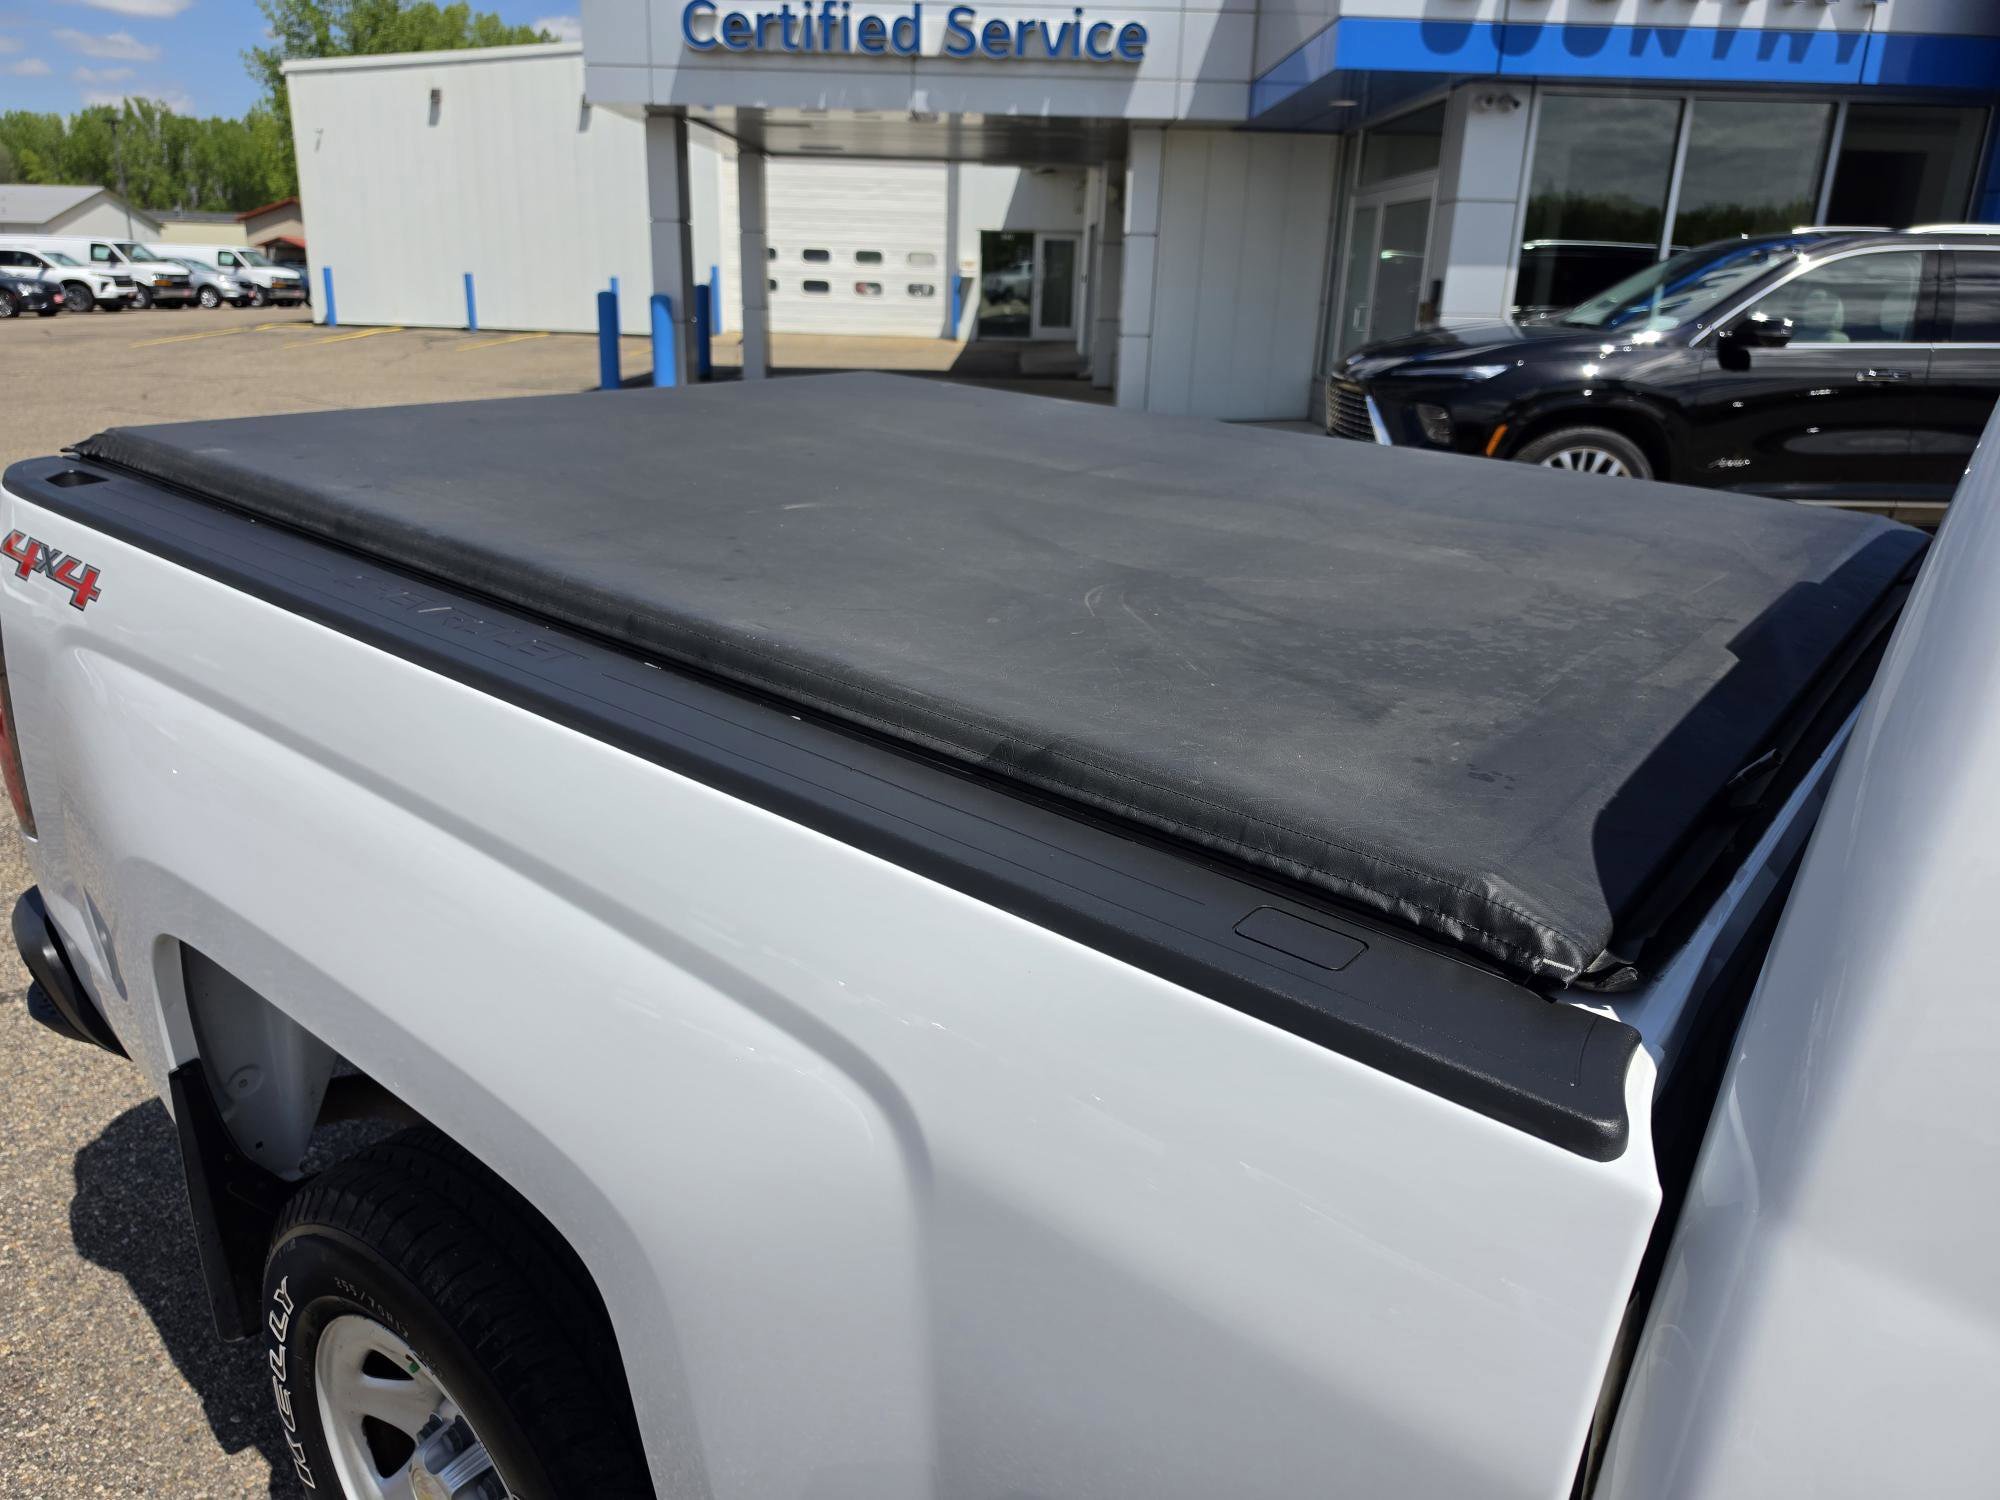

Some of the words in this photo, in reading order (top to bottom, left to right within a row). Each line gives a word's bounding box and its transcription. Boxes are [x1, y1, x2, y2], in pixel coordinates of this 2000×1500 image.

[682, 0, 921, 54] Certified
[946, 5, 1148, 61] Service
[268, 1275, 317, 1489] KELLY
